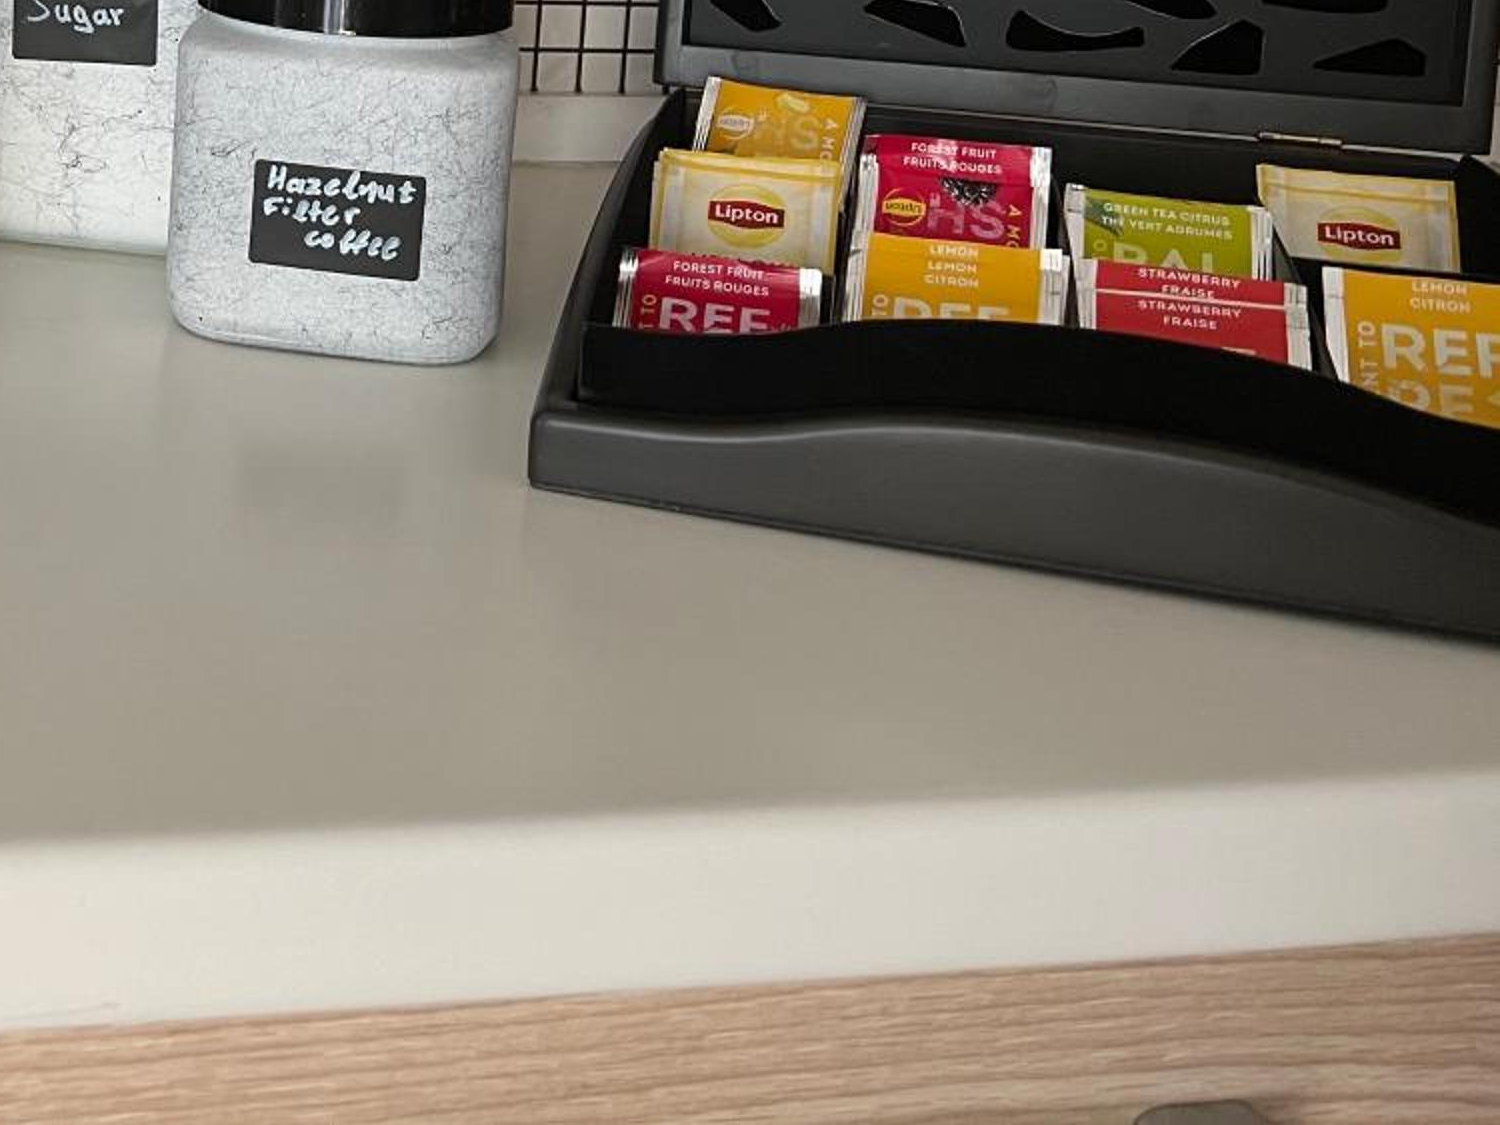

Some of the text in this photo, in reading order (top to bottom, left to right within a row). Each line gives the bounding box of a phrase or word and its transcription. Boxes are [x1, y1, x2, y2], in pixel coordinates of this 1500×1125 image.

[911, 142, 996, 158] FOREST FRUIT
[267, 164, 417, 204] Hazelnut
[263, 197, 361, 226] Filter
[715, 203, 779, 224] Lipton
[1103, 203, 1230, 226] GREEN TEA CITRUS
[1129, 219, 1164, 232] VERT
[1166, 224, 1233, 240] AGRUMES
[1325, 226, 1394, 246] Lipton
[930, 245, 979, 257] LEMON
[673, 261, 765, 280] FOREST FRUIT
[927, 262, 977, 272] LEMON
[665, 275, 770, 296] FRUITS ROUGES
[924, 274, 979, 287] CITRON
[1138, 268, 1241, 289] STRAWBERRY
[1411, 280, 1467, 295] LEMON
[1161, 284, 1216, 299] FRAISE
[1137, 299, 1242, 319] STRAWBERRY
[1410, 296, 1471, 313] CITRON
[1163, 316, 1218, 330] FRAISE
